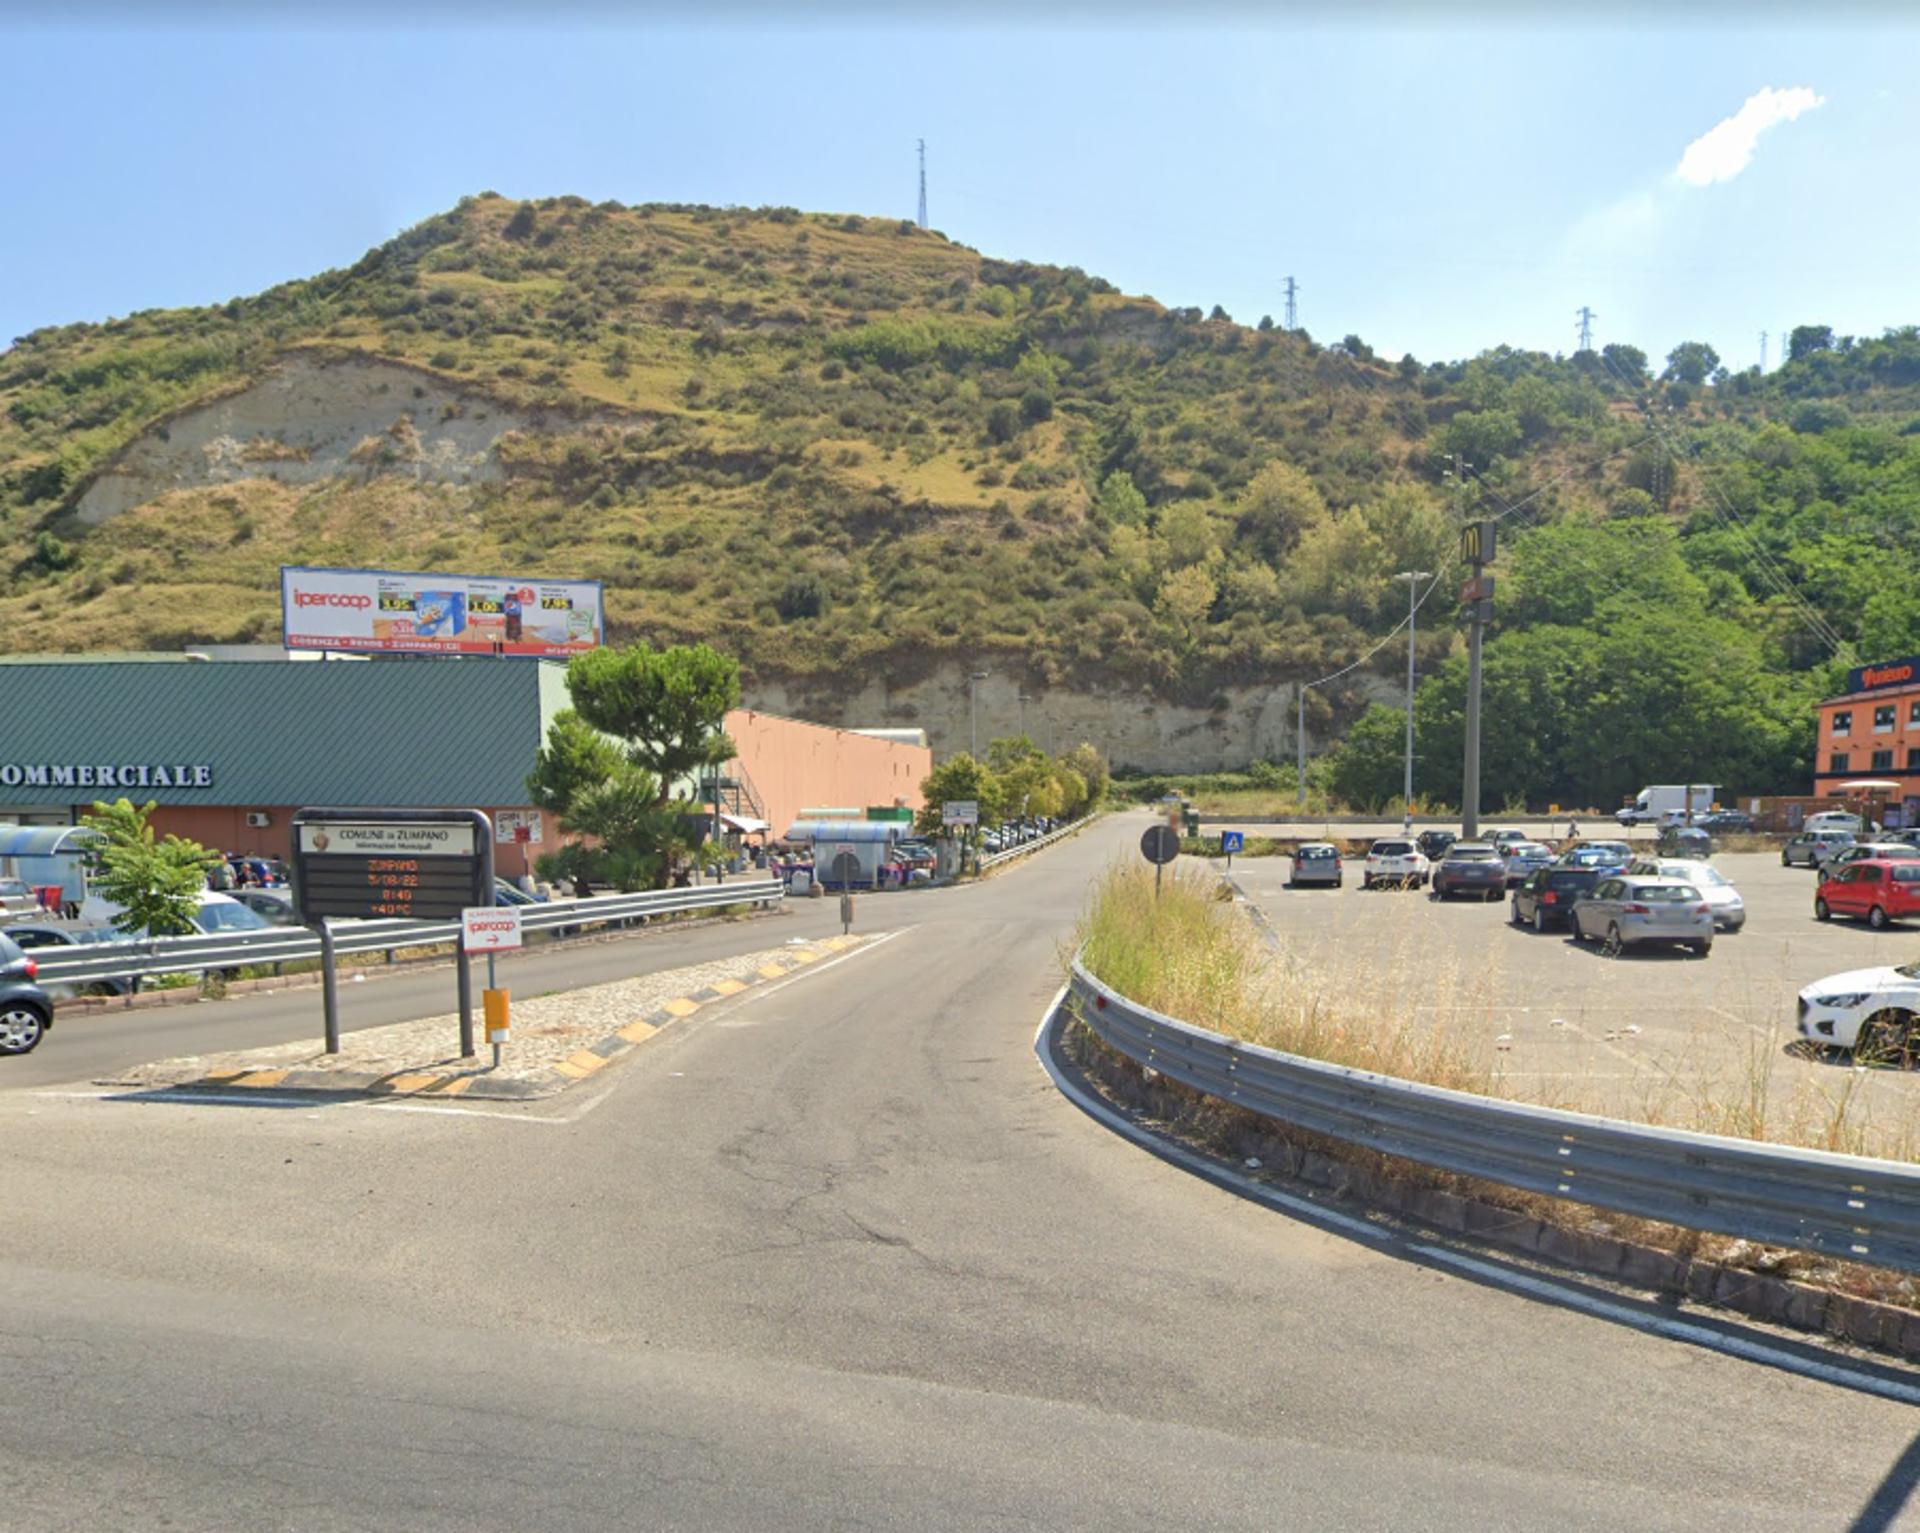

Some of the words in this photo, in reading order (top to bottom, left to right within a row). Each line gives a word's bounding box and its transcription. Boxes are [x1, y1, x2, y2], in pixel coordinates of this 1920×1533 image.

[293, 587, 371, 613] ipercoop
[0, 764, 212, 787] OMMERCIALE
[340, 829, 384, 840] COMUNE
[396, 829, 449, 841] ZUMPANO
